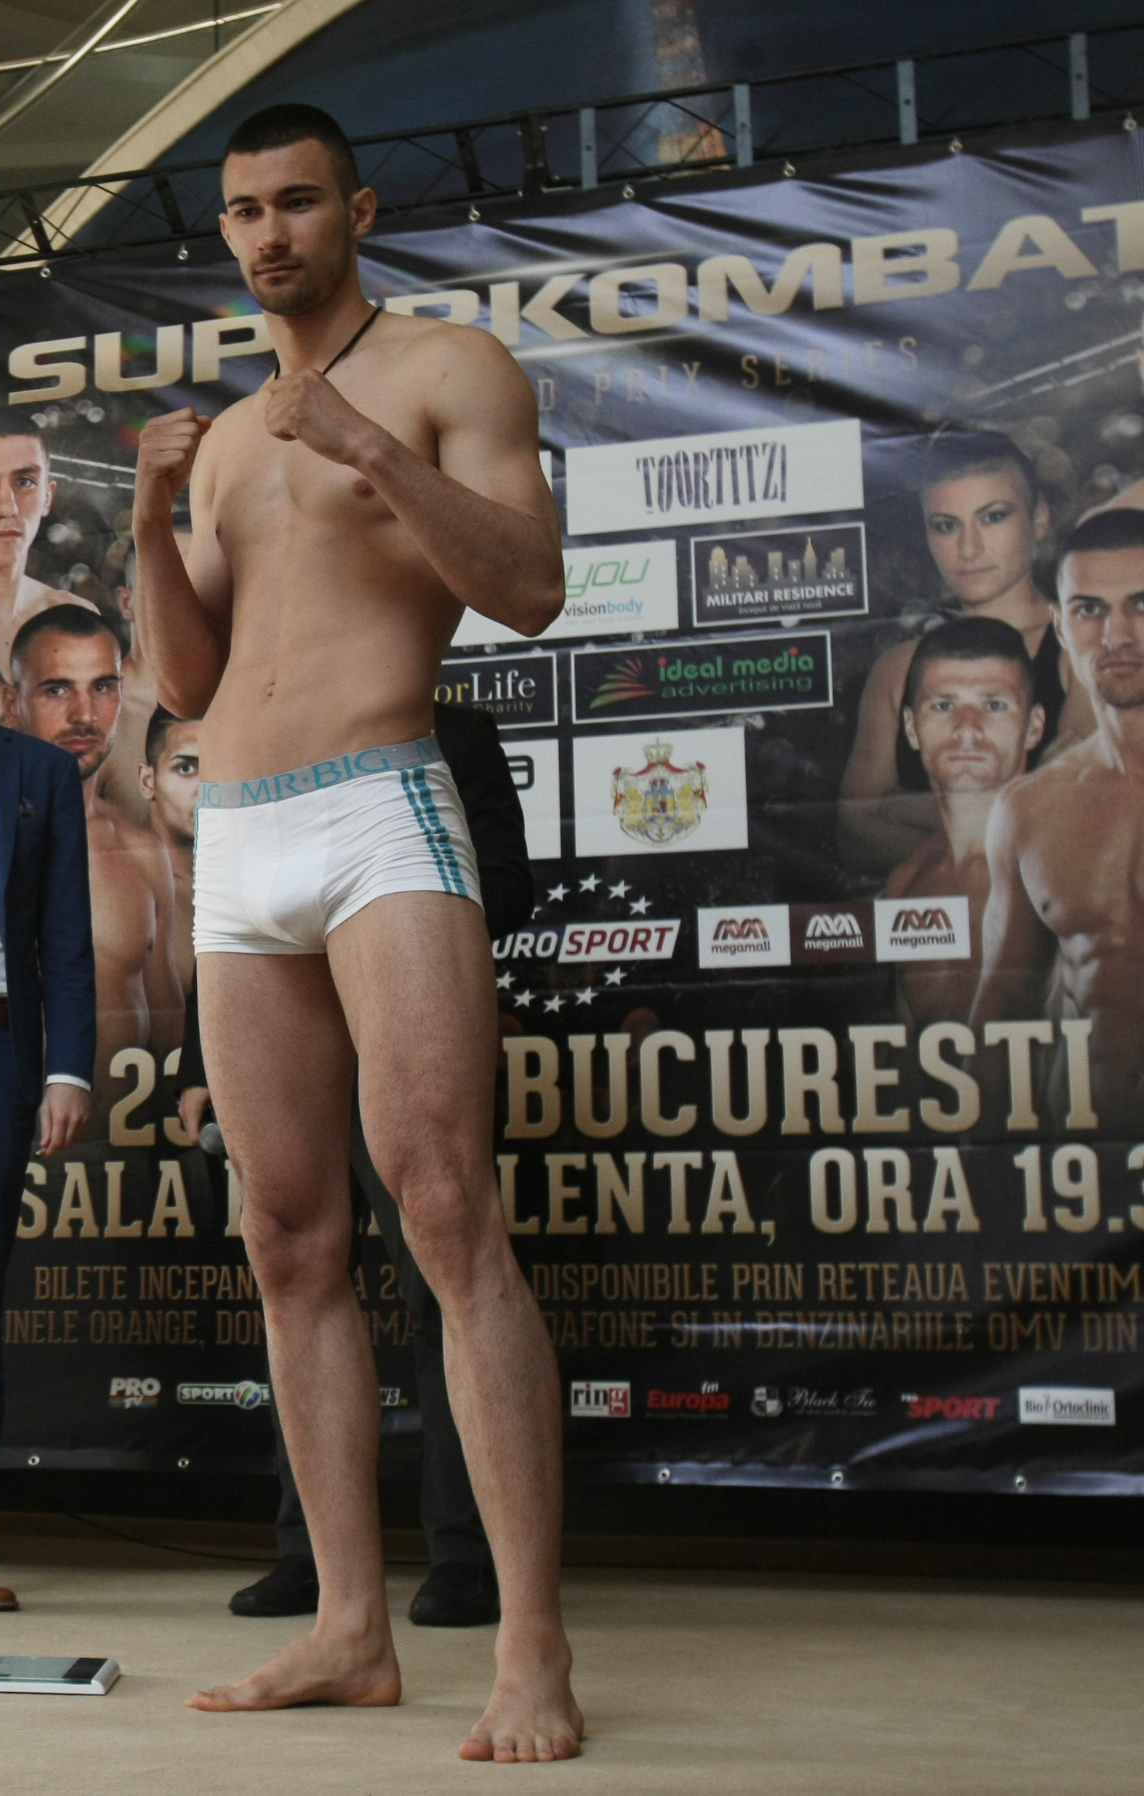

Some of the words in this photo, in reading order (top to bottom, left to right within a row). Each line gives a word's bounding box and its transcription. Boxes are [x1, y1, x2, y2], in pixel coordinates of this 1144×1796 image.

[8, 198, 1144, 406] SUPRKOMBAT
[593, 362, 702, 406] PRIX
[741, 336, 920, 390] SERIES
[706, 591, 769, 608] MILITARI
[774, 583, 854, 603] RESIDENCE
[658, 656, 723, 682] ideal
[733, 646, 814, 677] media
[661, 669, 813, 699] advertising
[711, 940, 771, 956] megamall
[805, 936, 864, 951] megamall
[890, 932, 956, 948] megamall
[503, 1019, 1099, 1139] BUCURESTI
[16, 1160, 195, 1239] SALA
[809, 1147, 980, 1233] ORA
[35, 1266, 127, 1300] BILETE
[533, 1264, 718, 1300] DISPONIBILE
[732, 1263, 804, 1300] PRIN
[818, 1263, 970, 1301] RETEAUA
[983, 1263, 1143, 1301] EVENTIM
[90, 1310, 205, 1350] ORANGE,
[671, 1311, 700, 1348] SI
[713, 1311, 743, 1348] IN
[988, 1312, 1067, 1351] OMV
[1082, 1312, 1128, 1352] DIN
[110, 1377, 161, 1396] PRO
[181, 1387, 234, 1400] SPORT
[124, 1395, 144, 1408] TV
[648, 1391, 731, 1411] Europa
[908, 1397, 1001, 1419] SPORT
